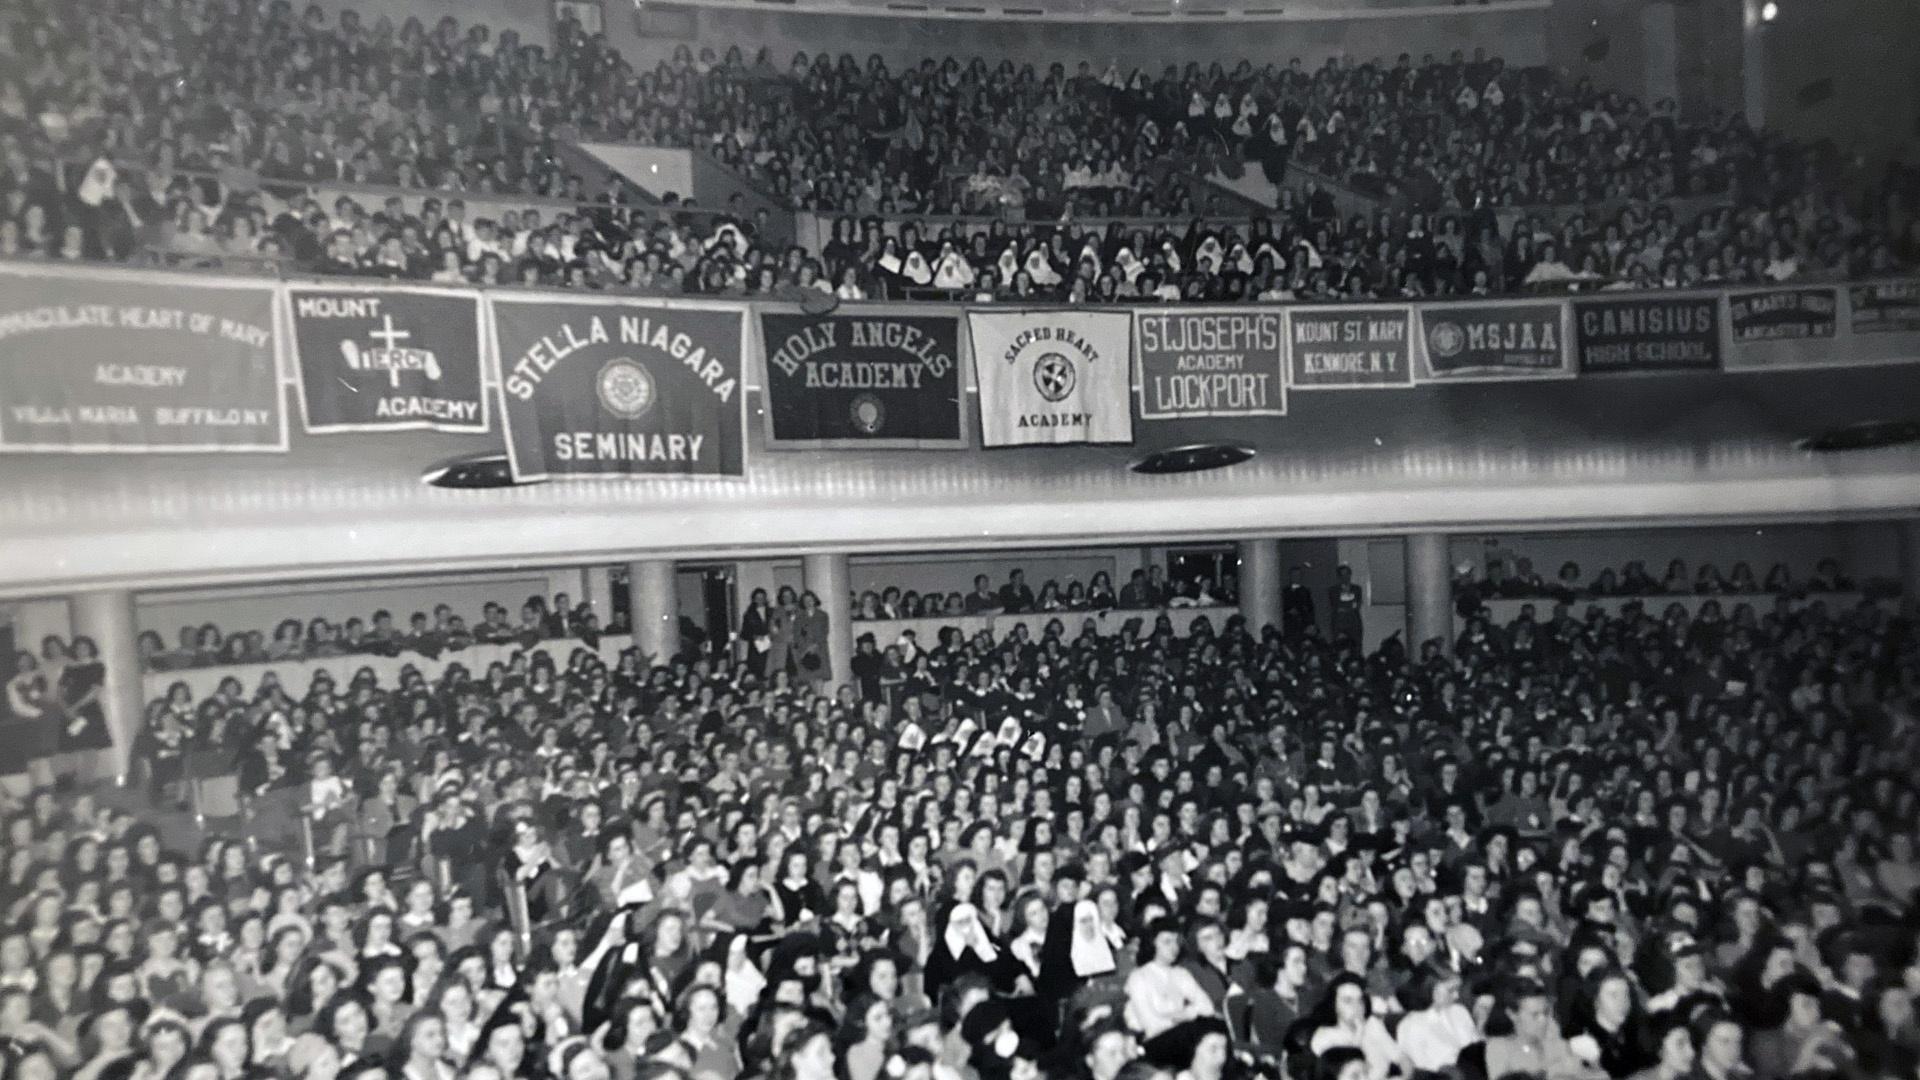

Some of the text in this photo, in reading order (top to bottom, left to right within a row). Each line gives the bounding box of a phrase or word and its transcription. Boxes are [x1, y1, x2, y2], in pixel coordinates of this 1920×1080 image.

[299, 298, 381, 318] MOUNT
[1583, 305, 1711, 336] CANISIUS
[119, 306, 184, 330] HEART
[188, 312, 215, 333] OF
[220, 318, 270, 348] MARY
[1295, 320, 1339, 344] MOUNT
[1368, 320, 1404, 342] MARY
[772, 322, 953, 379] HOLY ANGELS
[1004, 326, 1099, 365] SACRED HEART
[1584, 343, 1631, 364] HIGH
[506, 315, 736, 404] STELLA NIAGARA
[1177, 354, 1244, 371] ACADEMY
[94, 363, 188, 387] ACADEMY
[805, 361, 924, 389] ACADEMY
[1155, 372, 1269, 411] LOCKPORT
[78, 405, 139, 424] MARIA
[375, 396, 479, 420] ACADEMY
[1018, 412, 1093, 428] ACADEMY
[554, 432, 704, 462] SEMINARY
